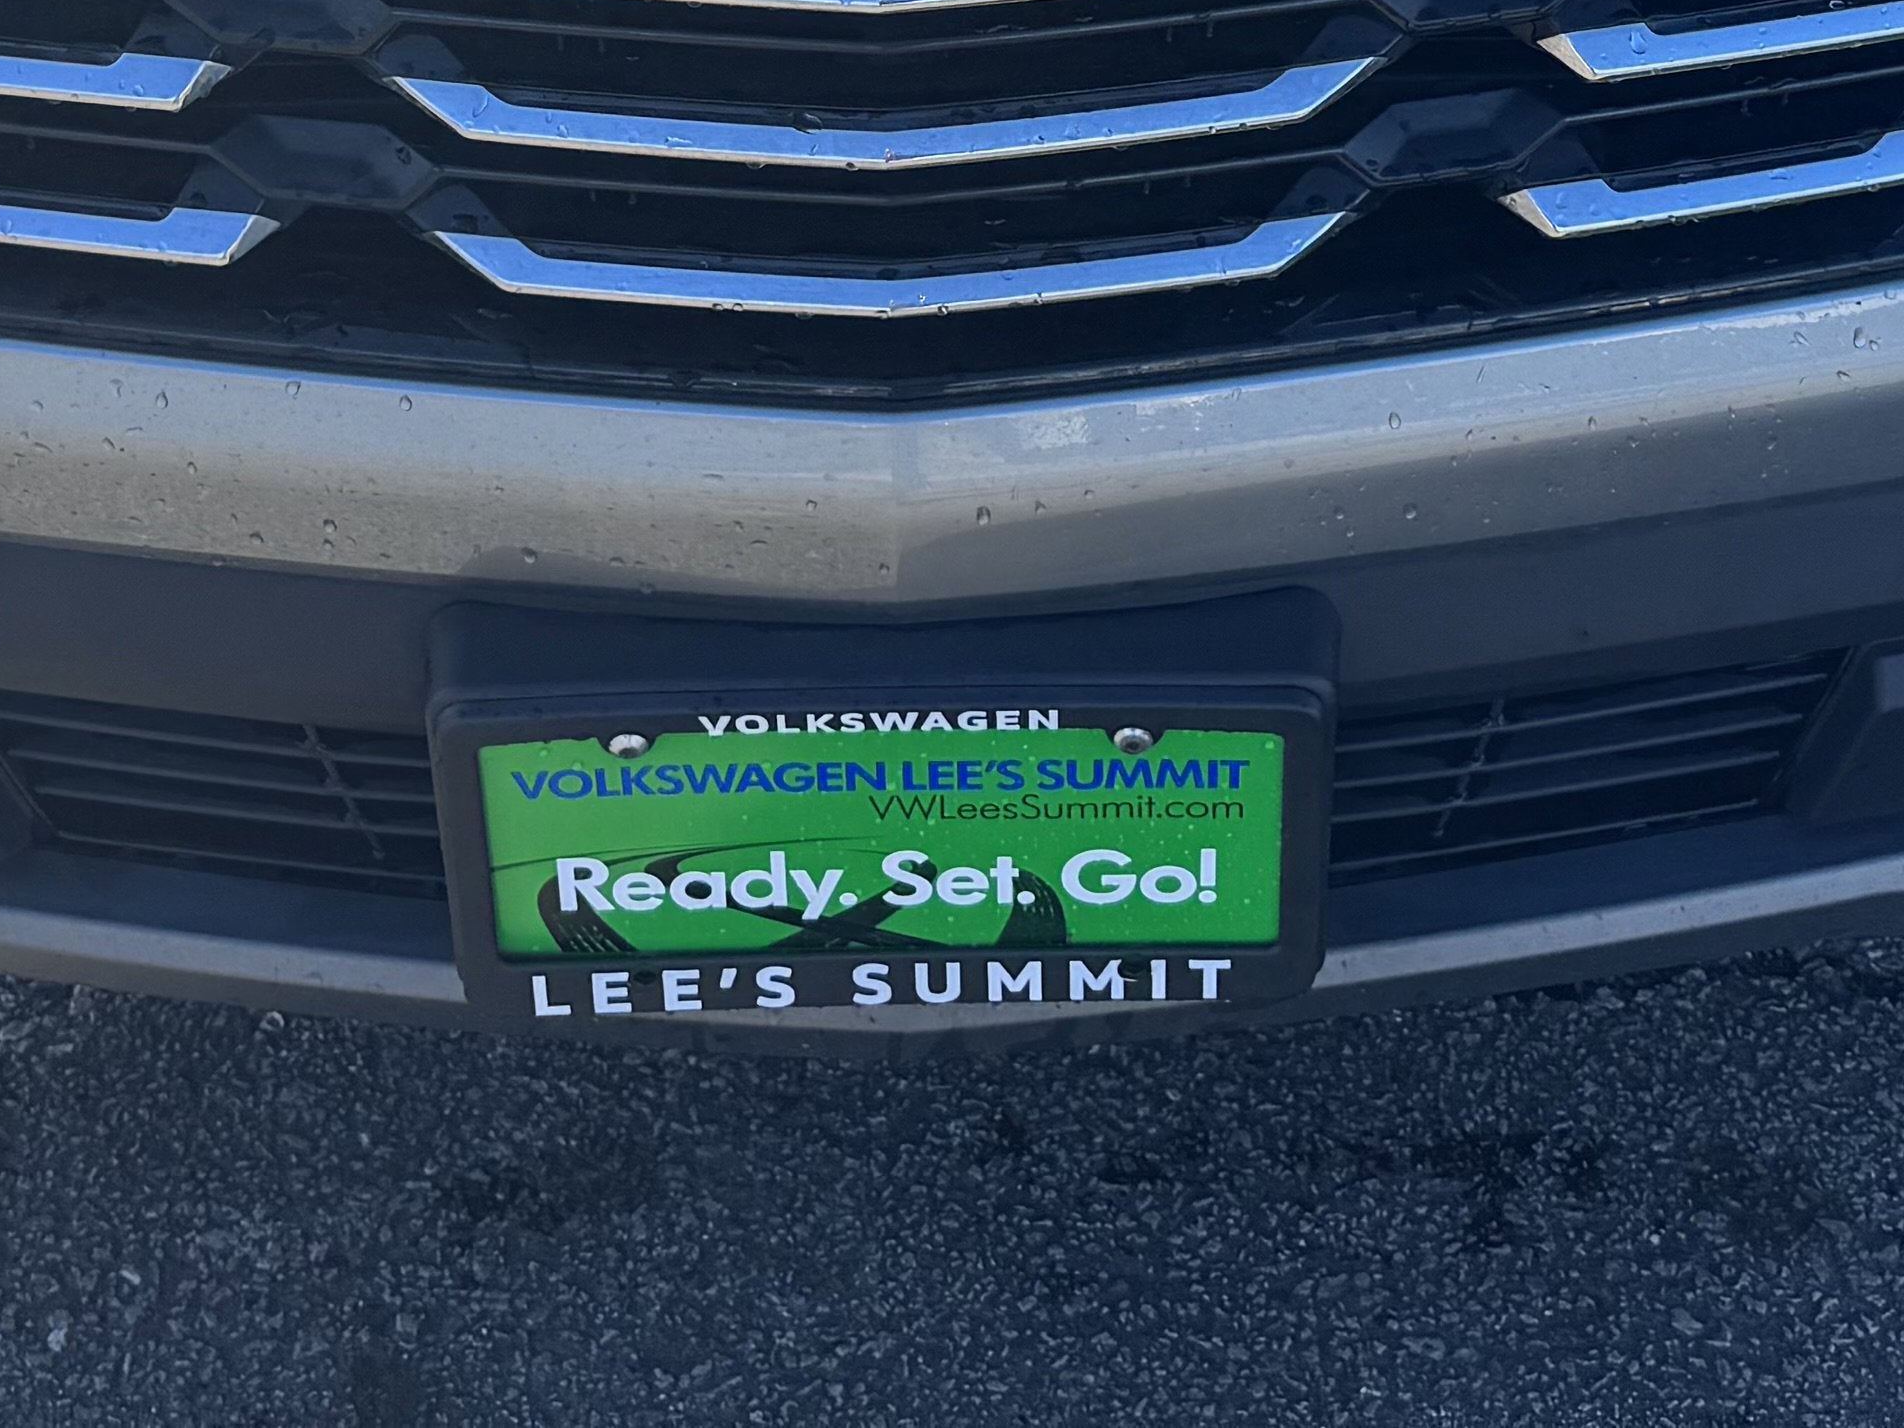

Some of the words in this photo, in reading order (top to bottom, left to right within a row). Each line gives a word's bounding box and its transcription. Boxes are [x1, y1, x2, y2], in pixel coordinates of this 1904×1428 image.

[698, 709, 1060, 736] VOLKSWAGEN
[511, 760, 887, 800] VOLKSWAGEN
[902, 759, 1025, 791] LEE'S
[1037, 759, 1250, 791] SUMMIT
[868, 793, 1244, 819] VWLeesSummit.com
[556, 850, 858, 921] Ready.
[881, 850, 1035, 906] Set.
[1061, 848, 1217, 905] Go!
[532, 966, 796, 1017] LEE'S
[852, 959, 1231, 1006] SUMMIT
